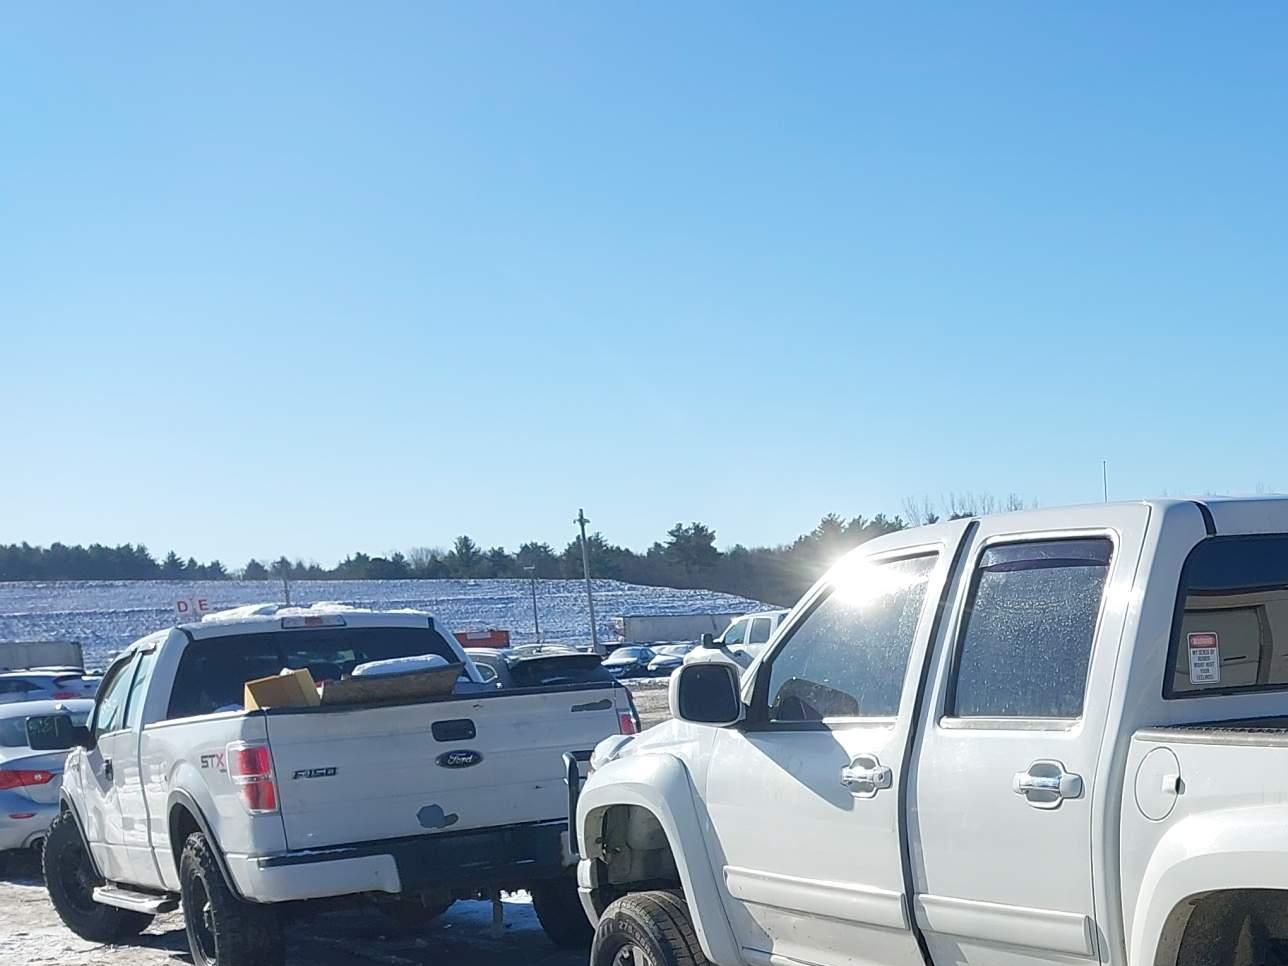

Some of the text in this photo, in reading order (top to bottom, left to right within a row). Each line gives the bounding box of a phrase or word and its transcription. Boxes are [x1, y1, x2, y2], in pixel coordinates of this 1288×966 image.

[177, 600, 188, 613] D
[198, 599, 209, 611] E
[200, 753, 224, 769] STX
[447, 753, 473, 765] Ford
